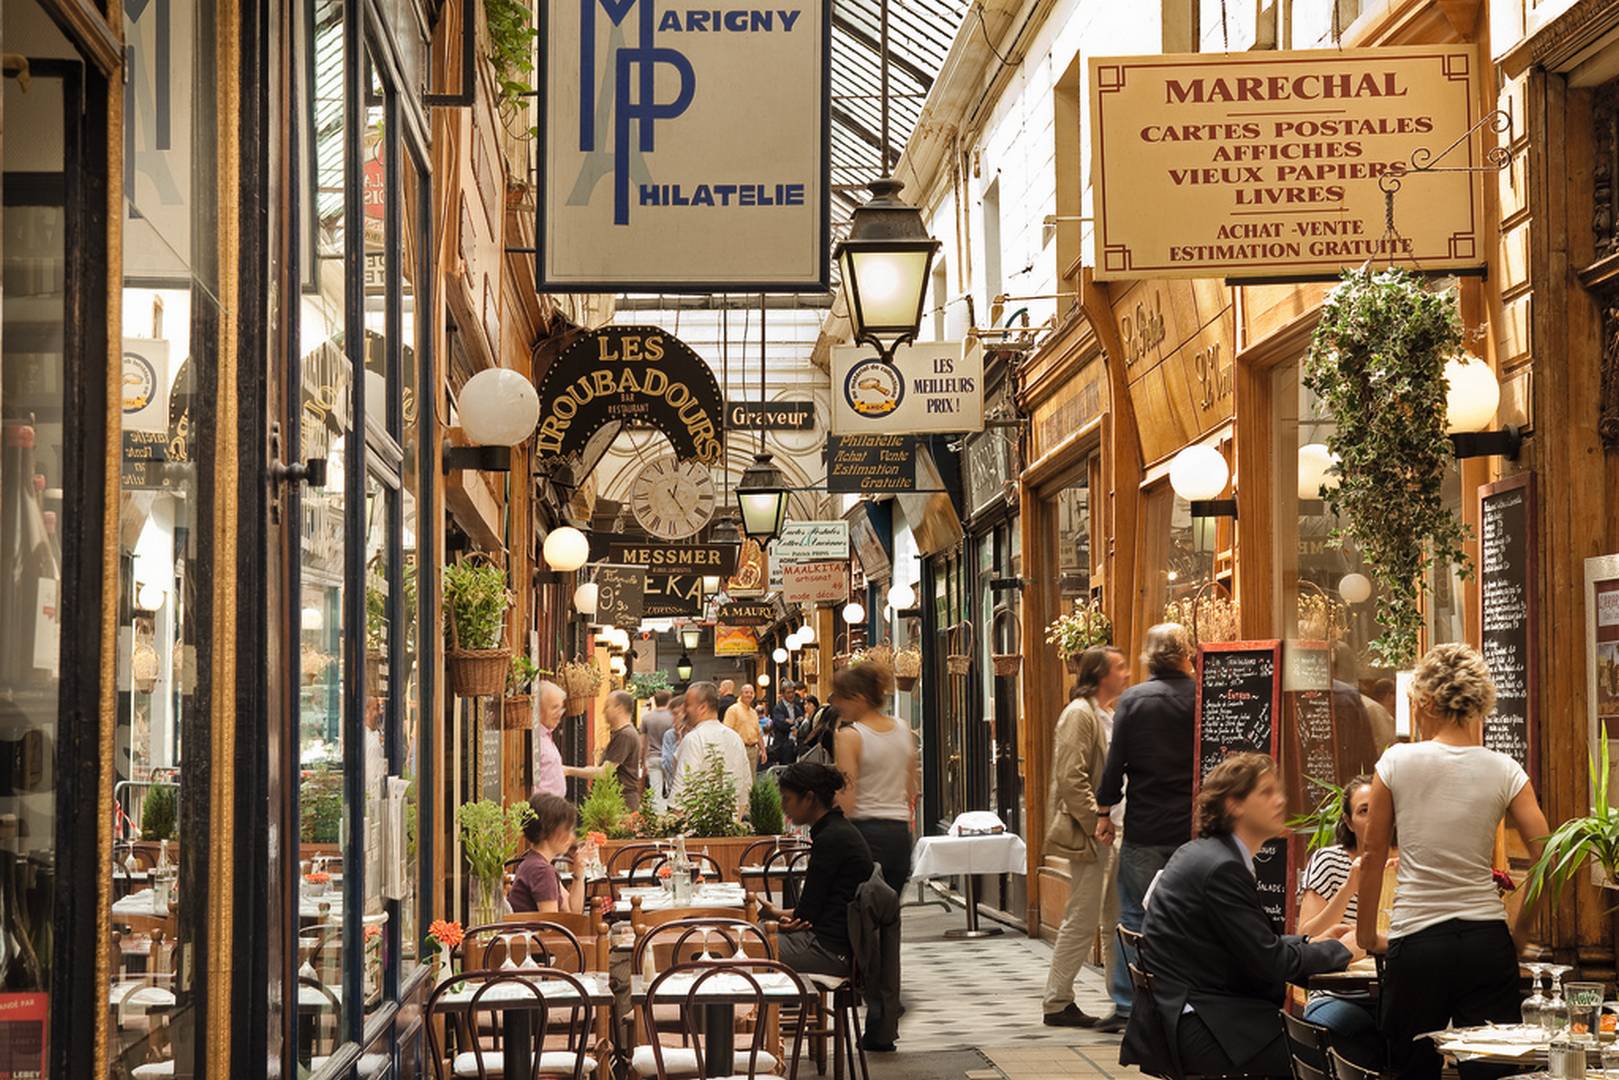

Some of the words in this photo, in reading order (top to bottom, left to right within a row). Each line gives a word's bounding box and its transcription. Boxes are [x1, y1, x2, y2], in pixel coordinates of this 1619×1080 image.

[1165, 72, 1408, 105] MARECHAL
[1140, 121, 1261, 143] CARTES
[1274, 116, 1434, 139] POSTALES
[1212, 141, 1363, 163] AFFICHES
[1167, 165, 1265, 186] VIEUX
[1276, 160, 1408, 182] PAPIERS
[1234, 186, 1346, 206] LIVRES
[1216, 222, 1284, 241] ACHAT
[1169, 242, 1301, 262] ESTIMATION
[1309, 238, 1414, 258] GRATUITE
[597, 335, 665, 362] LES
[933, 358, 954, 374] LES
[913, 377, 976, 394] MEILLEURS
[536, 367, 724, 464] TROUBADOURS
[926, 398, 953, 414] PRIX
[732, 406, 808, 426] Graveur
[834, 450, 868, 462] Achat
[880, 449, 909, 462] Vente
[832, 463, 899, 476] Estimation
[861, 476, 912, 488] Gratuite
[623, 549, 721, 565] MESSMER
[732, 607, 773, 620] MAURY
